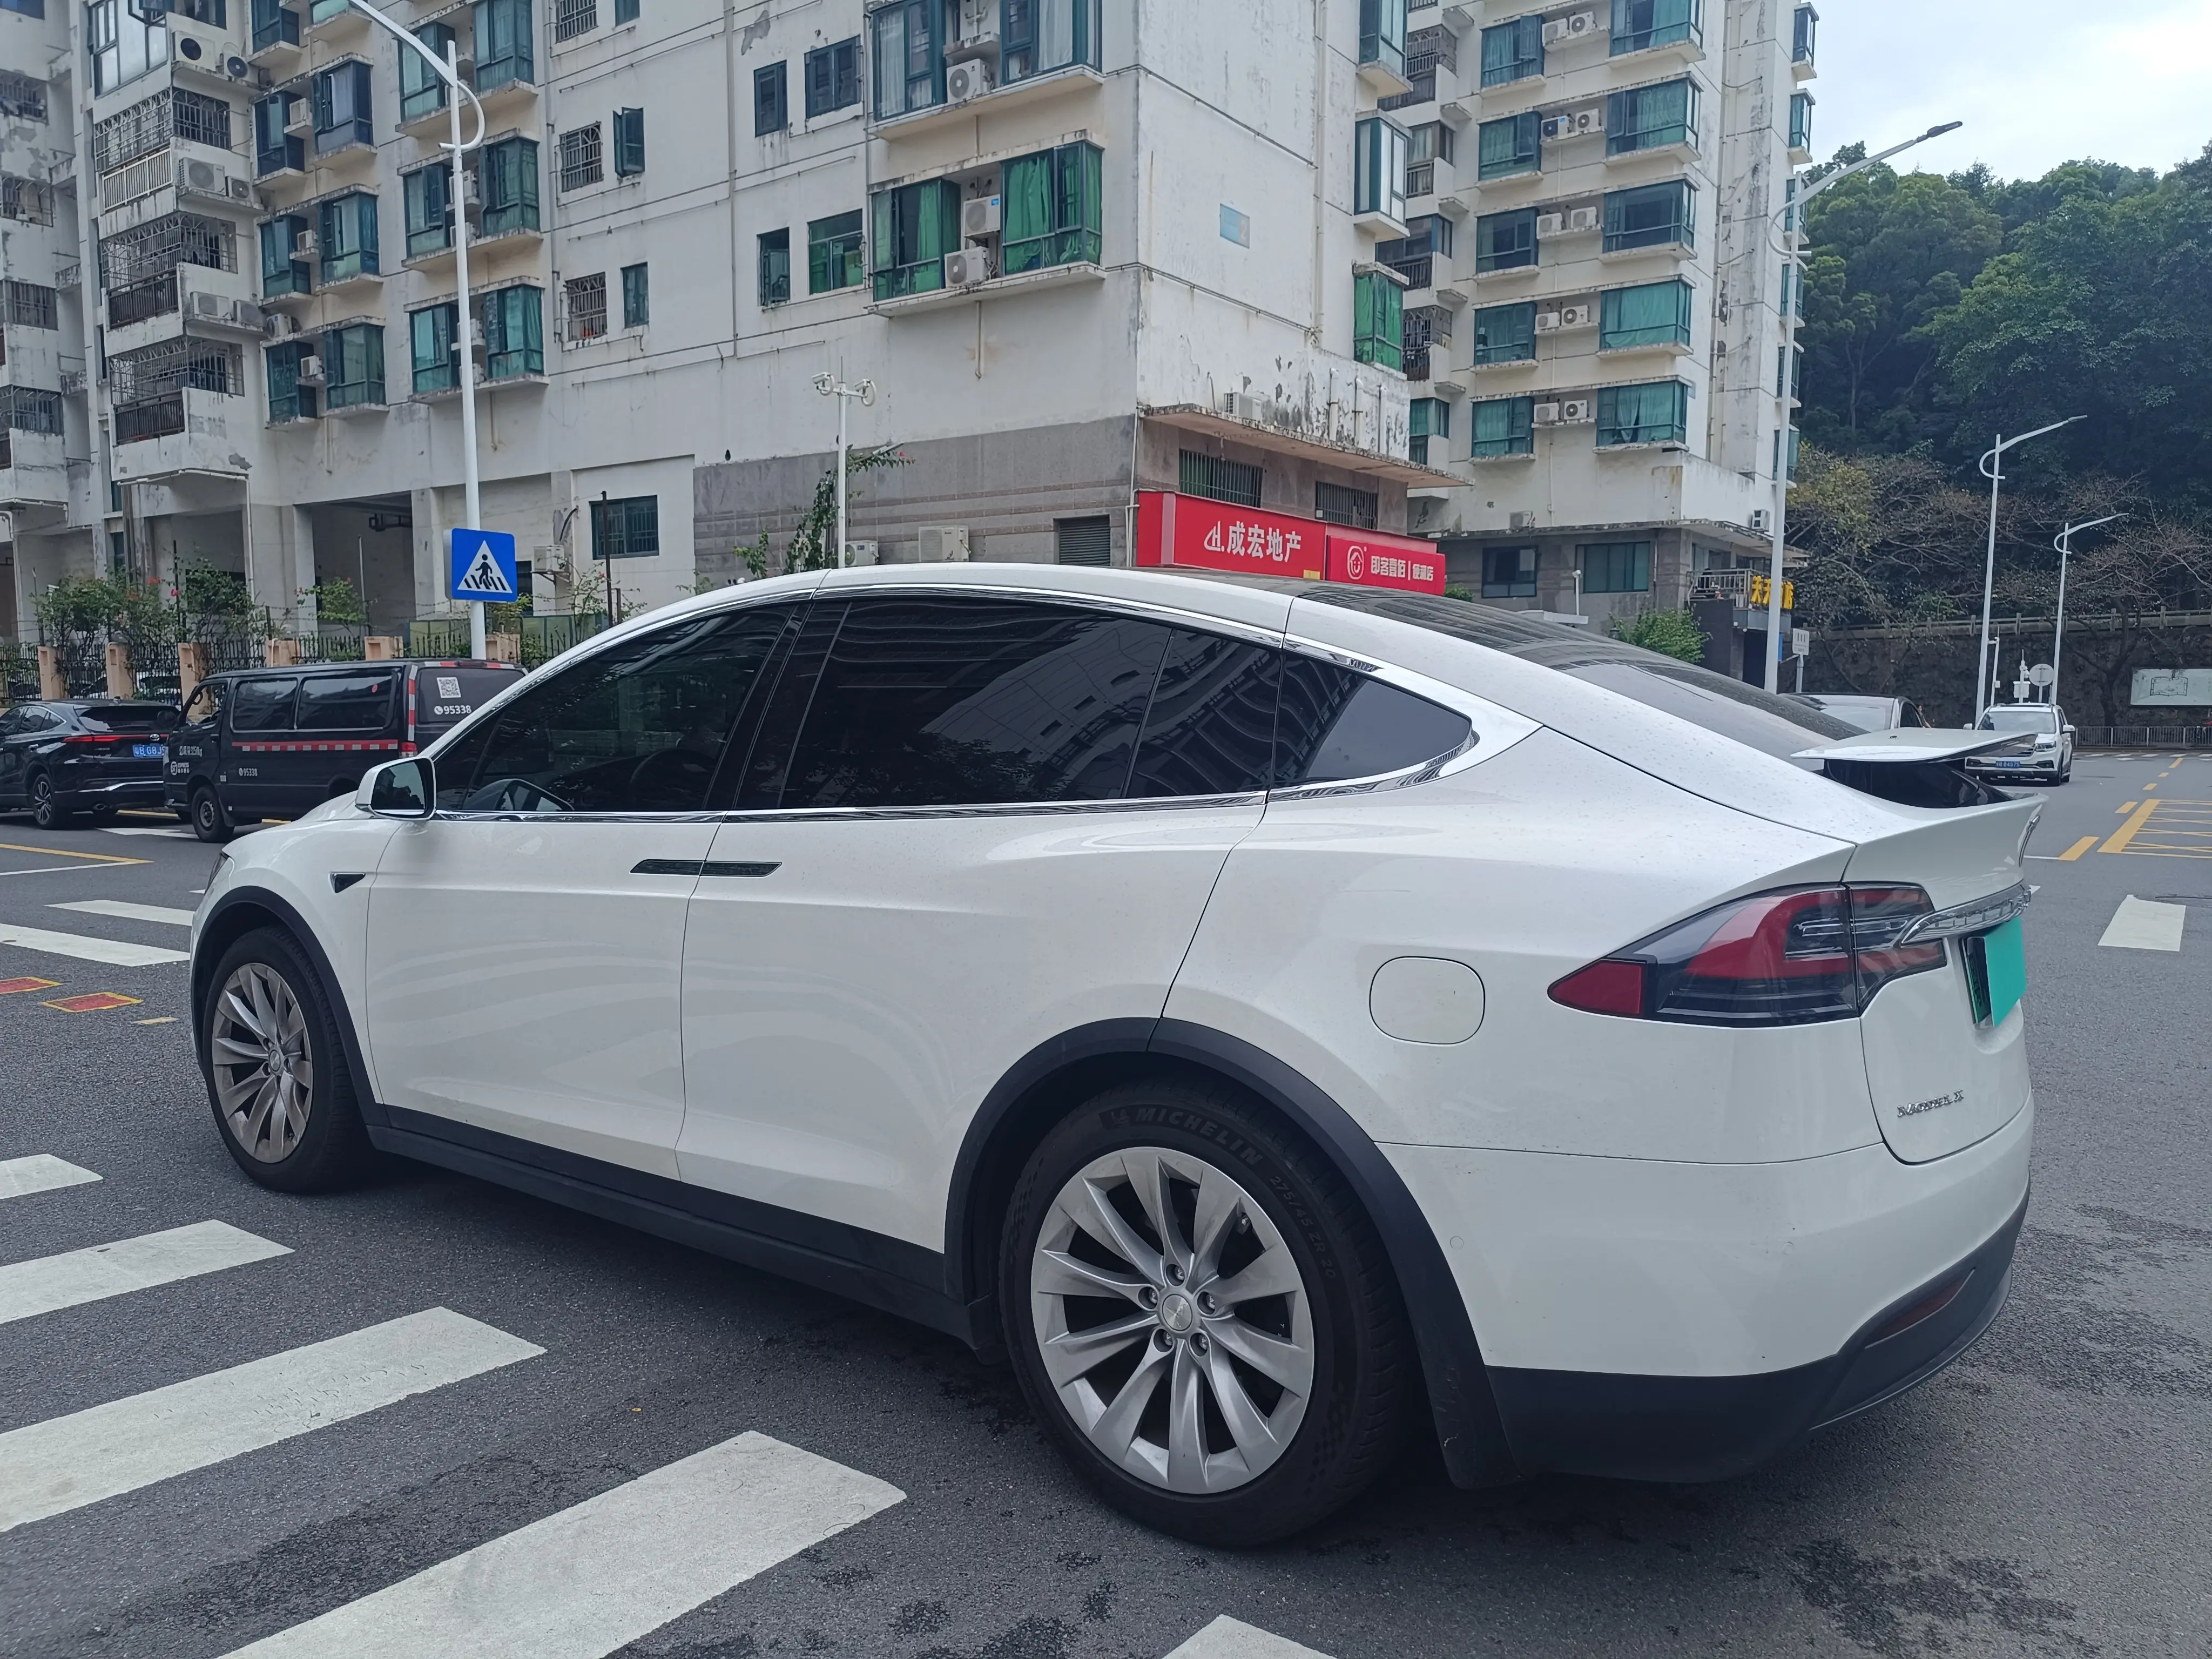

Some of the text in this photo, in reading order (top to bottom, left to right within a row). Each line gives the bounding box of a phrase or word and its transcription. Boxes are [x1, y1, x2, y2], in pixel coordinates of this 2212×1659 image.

[1227, 521, 1301, 563] 成宏地产
[443, 705, 471, 714] 95338
[1897, 1089, 1965, 1118] MODEL X
[1135, 1107, 1263, 1166] MICHELIN
[1269, 1175, 1336, 1279] 275/45 ZR 20
